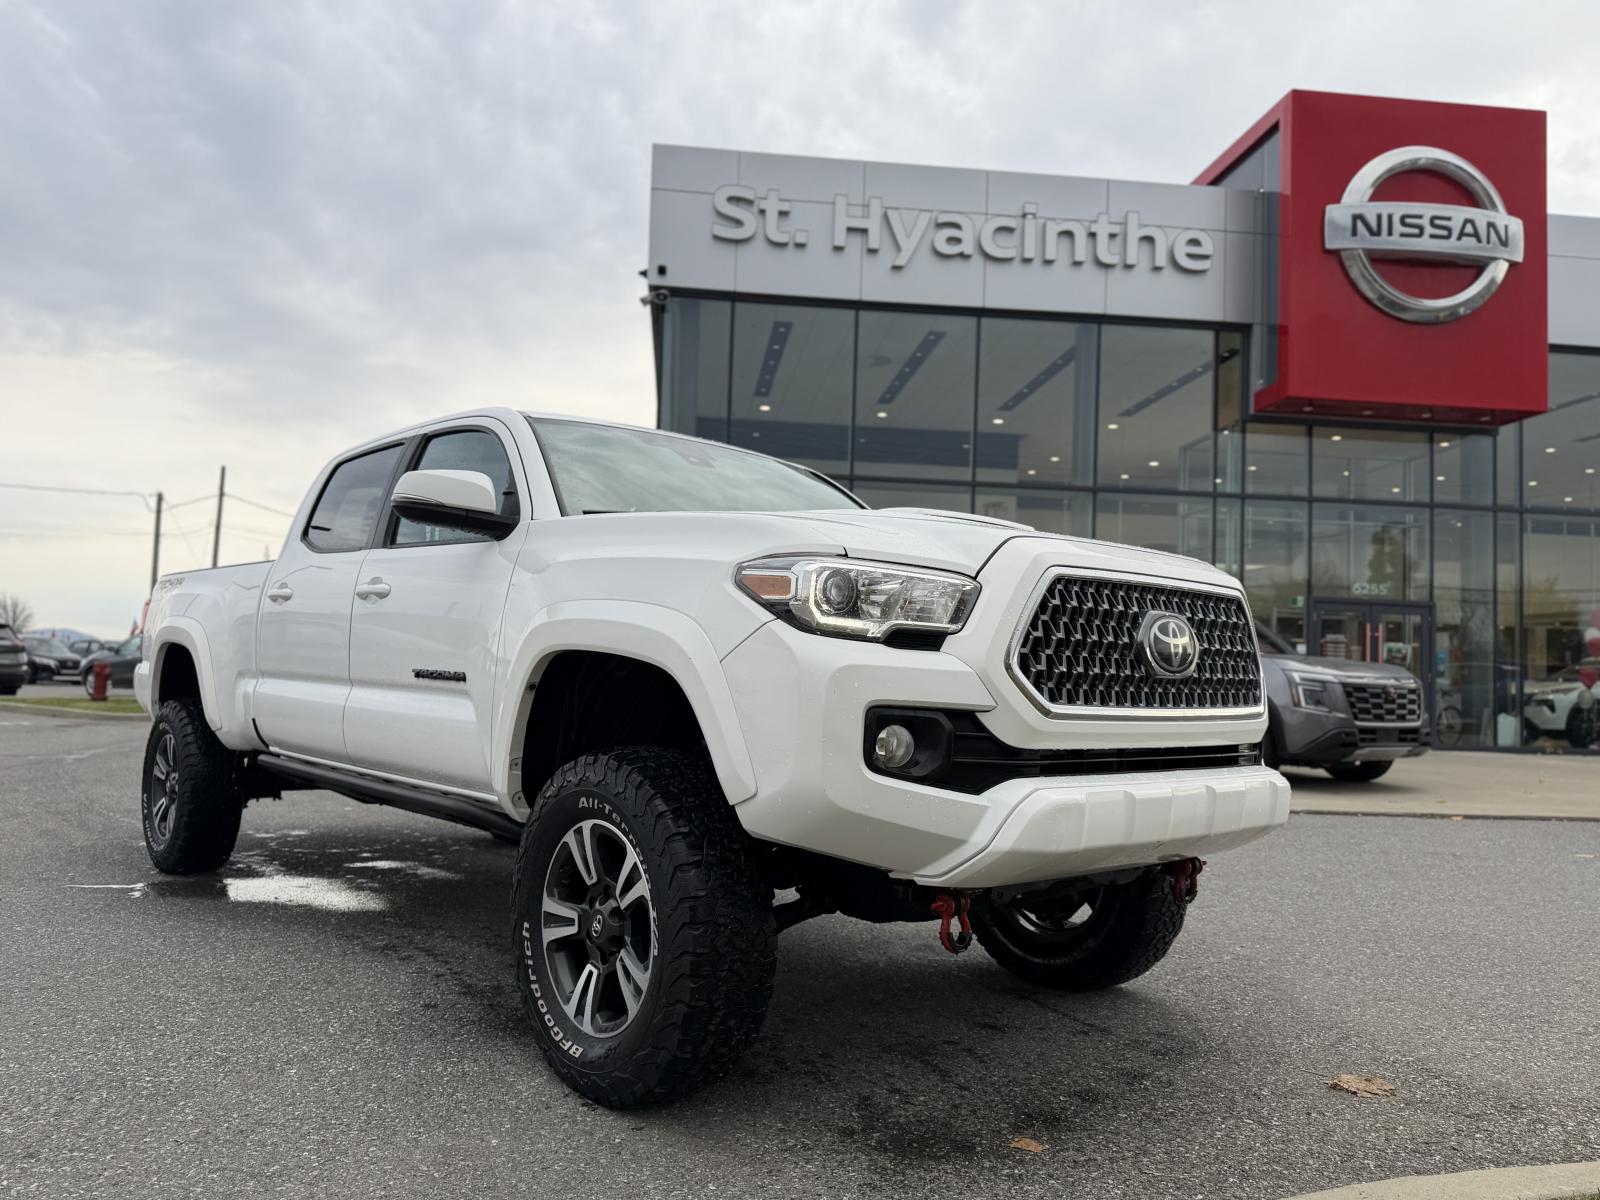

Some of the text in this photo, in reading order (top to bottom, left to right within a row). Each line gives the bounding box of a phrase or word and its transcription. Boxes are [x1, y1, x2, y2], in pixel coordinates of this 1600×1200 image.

[711, 184, 1214, 271] St. Hyacinthe
[1351, 212, 1509, 248] NISSAN
[521, 921, 584, 1059] BFGoodrich
